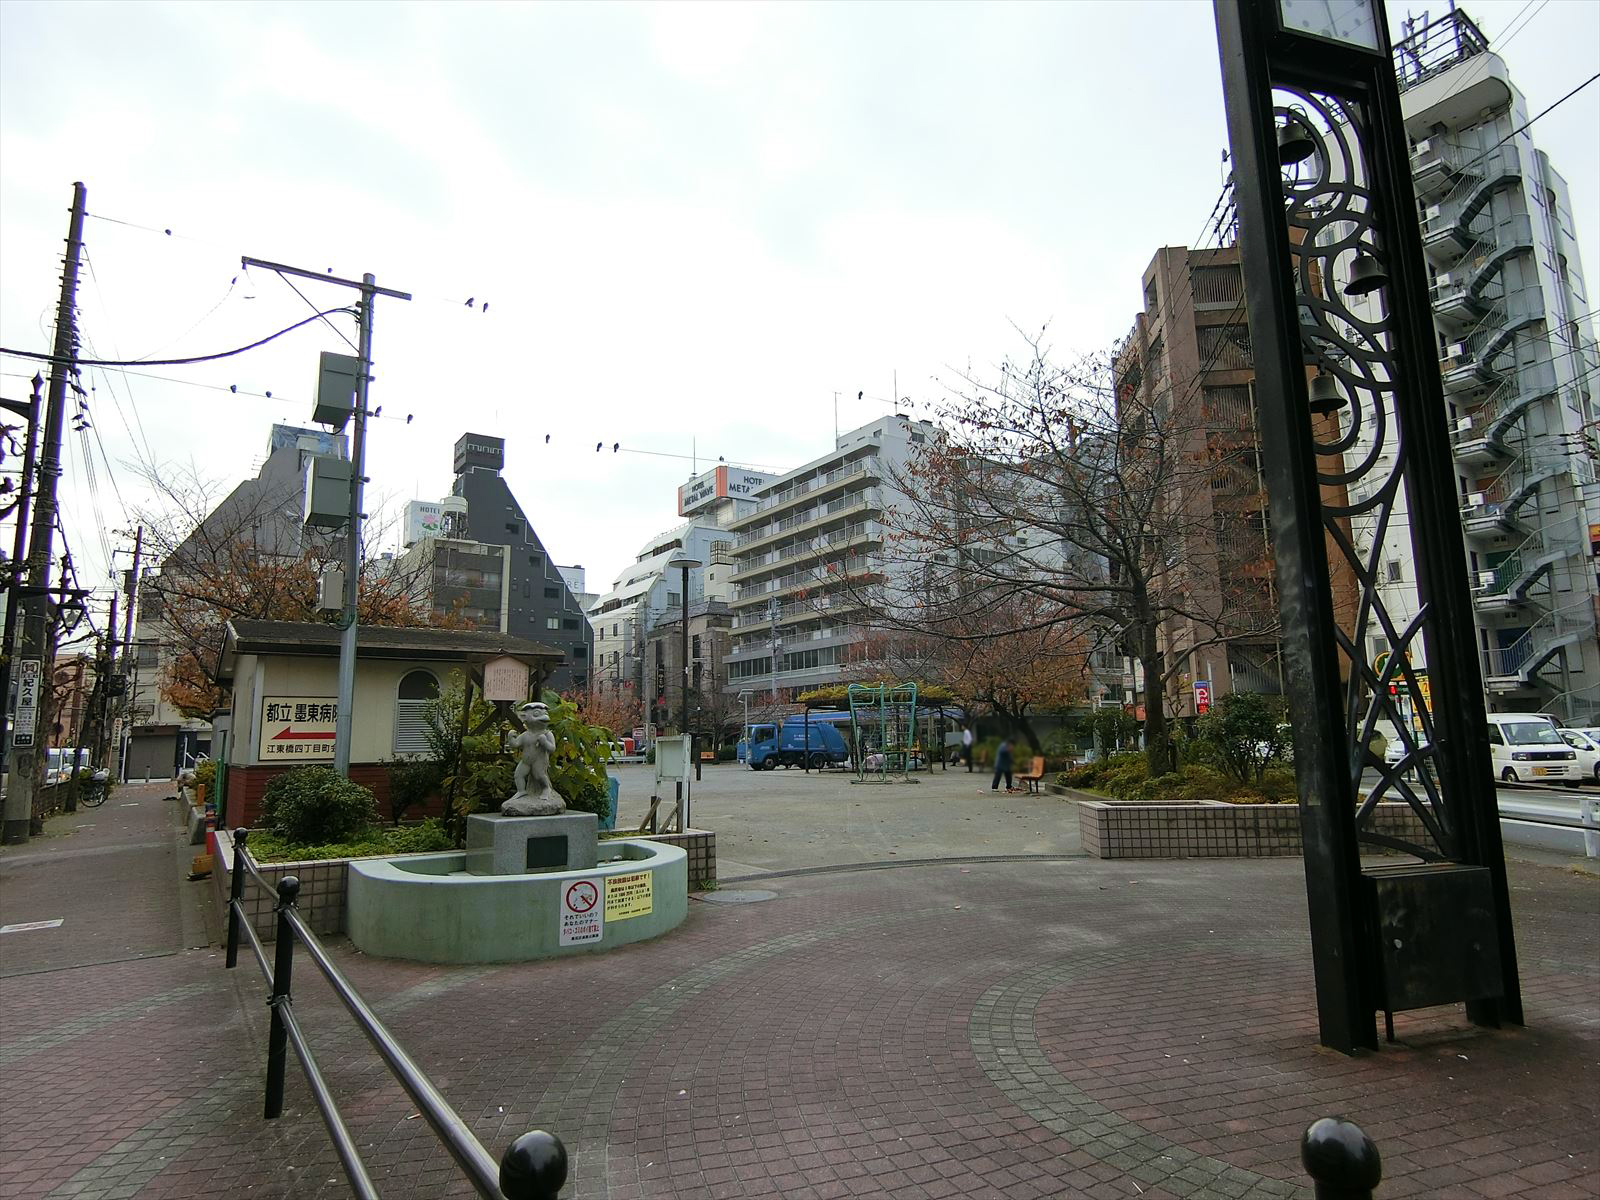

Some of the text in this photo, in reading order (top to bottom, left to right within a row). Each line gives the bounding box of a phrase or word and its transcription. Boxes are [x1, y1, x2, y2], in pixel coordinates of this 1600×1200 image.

[728, 483, 754, 494] META
[419, 505, 440, 514] HOTEL
[21, 678, 34, 706] 紀久屋
[564, 918, 599, 927] あなたのマナー
